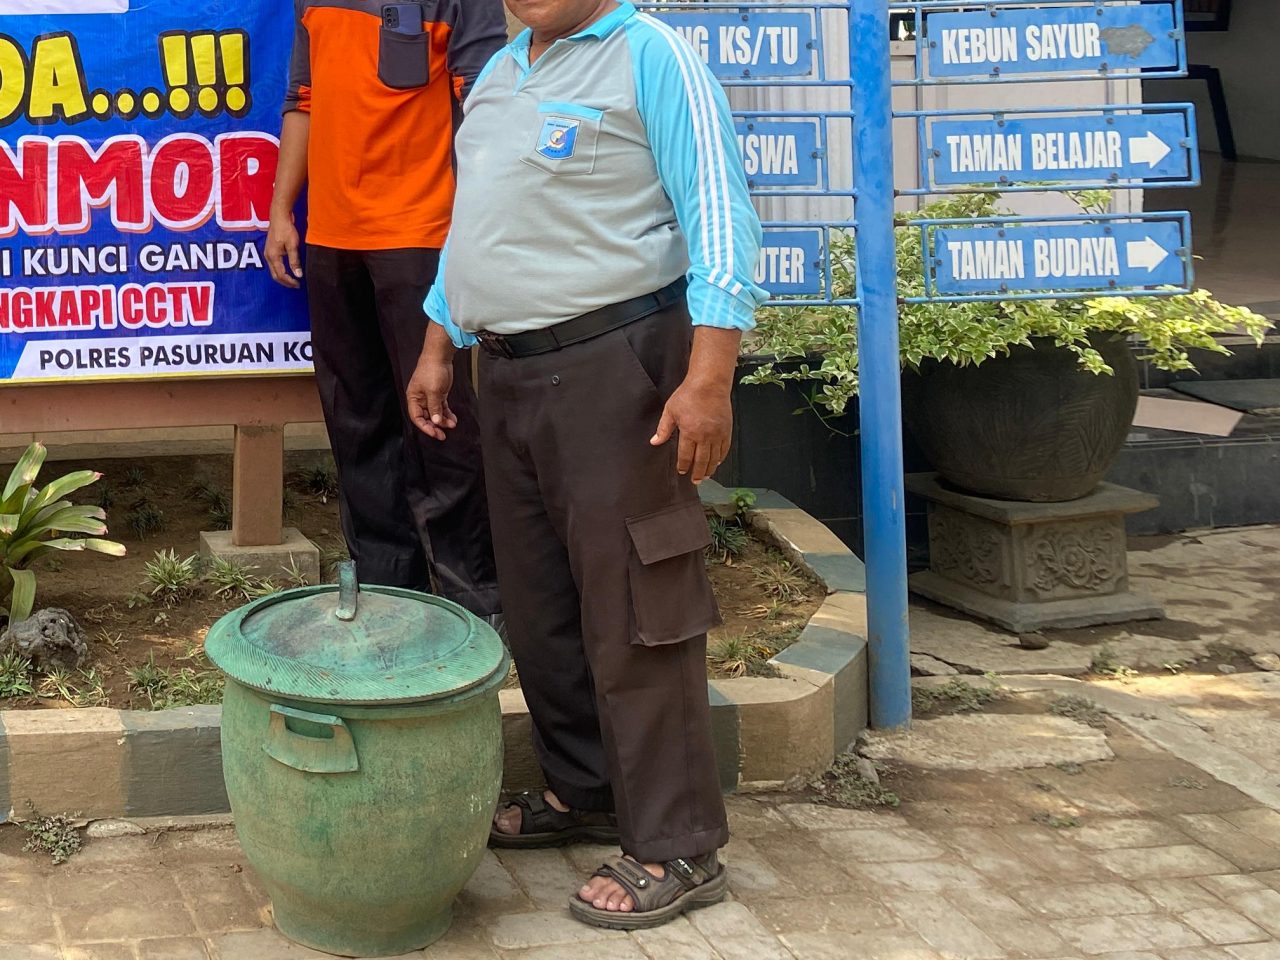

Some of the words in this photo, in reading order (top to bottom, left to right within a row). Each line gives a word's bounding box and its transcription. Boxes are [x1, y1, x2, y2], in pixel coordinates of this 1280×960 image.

[719, 25, 798, 65] KS/TU
[941, 26, 1018, 65] KEBUN
[1025, 22, 1102, 61] SAYUR
[946, 133, 1022, 173] TAMAN
[1031, 130, 1123, 171] BELAJAR
[23, 245, 128, 277] KUNCI
[139, 242, 263, 272] GANDA
[948, 239, 1024, 281] TAMAN
[1034, 236, 1120, 278] BUDAYA
[121, 285, 212, 326] CCTV
[39, 346, 131, 370] POLRES
[140, 342, 273, 368] PASURUAN
